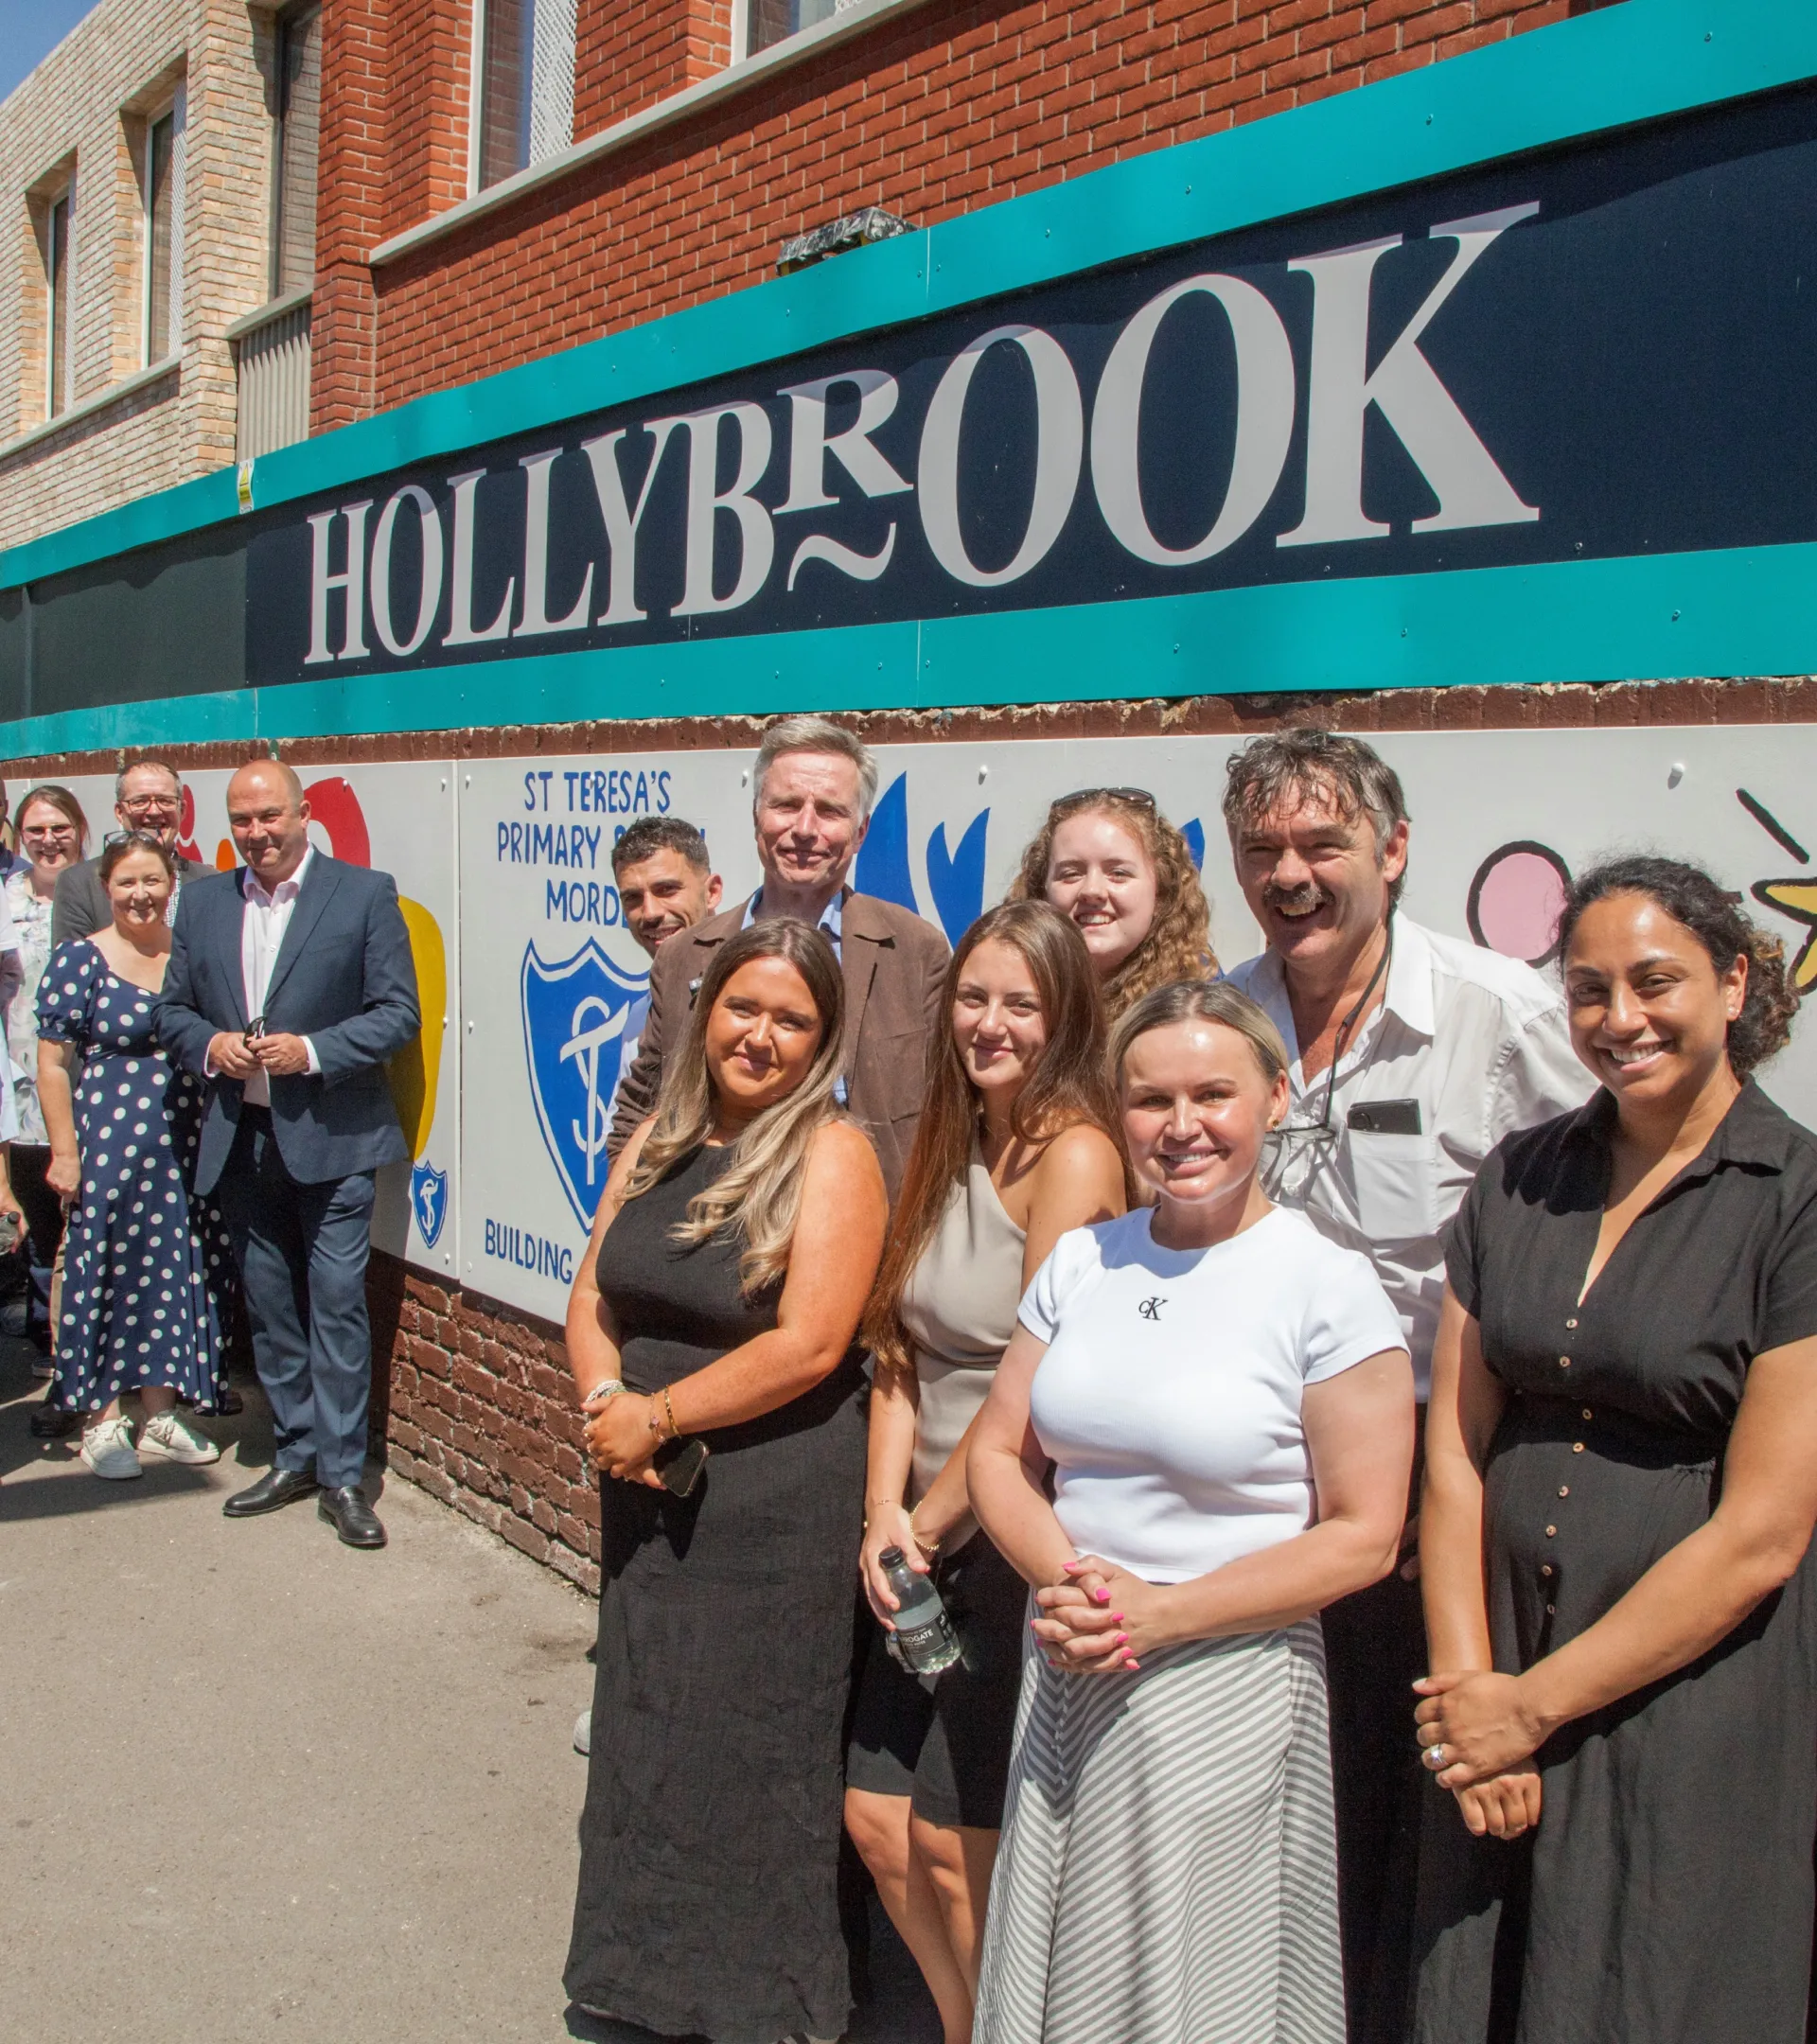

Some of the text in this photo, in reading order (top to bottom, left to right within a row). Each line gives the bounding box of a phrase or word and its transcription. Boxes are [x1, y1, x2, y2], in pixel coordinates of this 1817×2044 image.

[304, 201, 1540, 664] HOLLYBROOK
[524, 770, 671, 814] ST TERESA'S
[498, 821, 601, 870] PRIMARY
[485, 1218, 573, 1285] BUILDING
